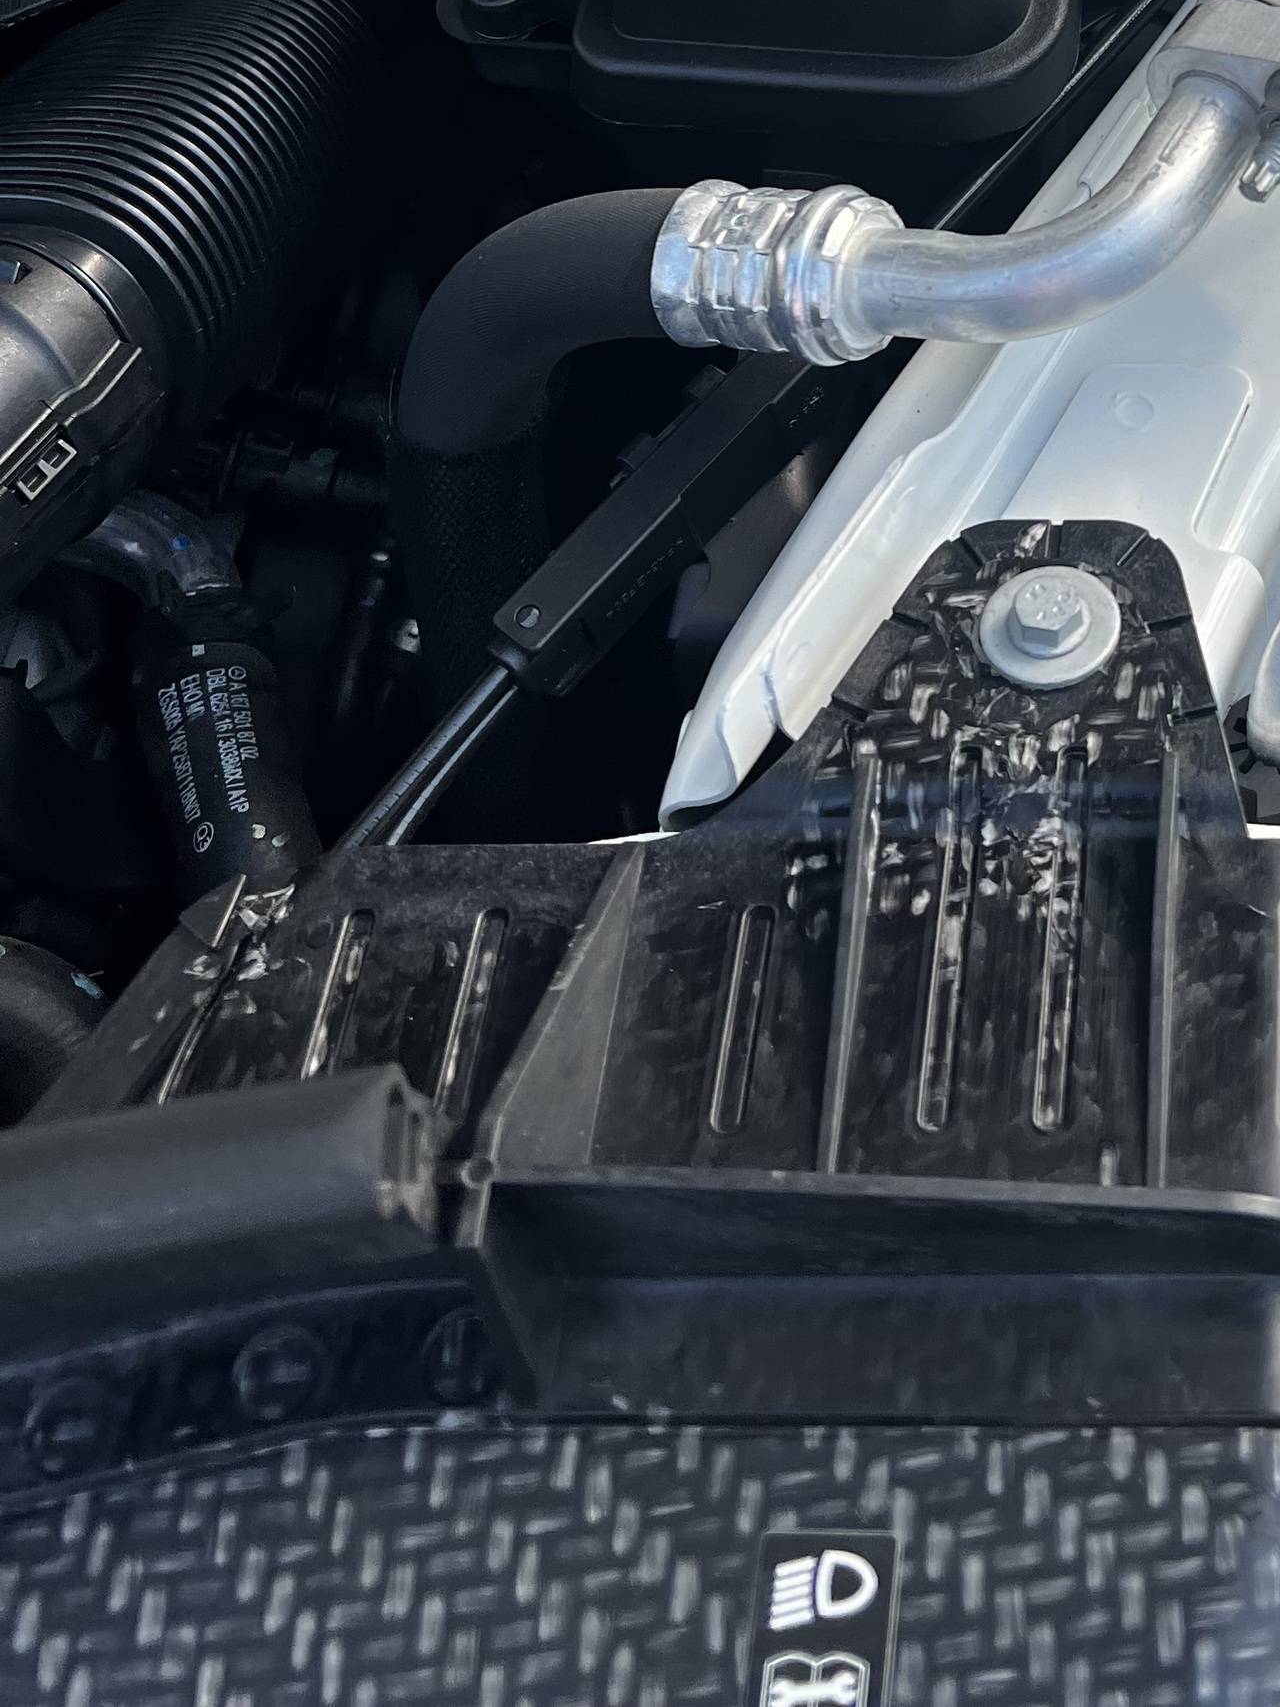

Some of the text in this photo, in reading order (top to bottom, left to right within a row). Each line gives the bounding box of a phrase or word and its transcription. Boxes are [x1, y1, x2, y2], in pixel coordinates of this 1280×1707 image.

[206, 668, 227, 693] DBL
[228, 682, 259, 760] A 167 501 87 02
